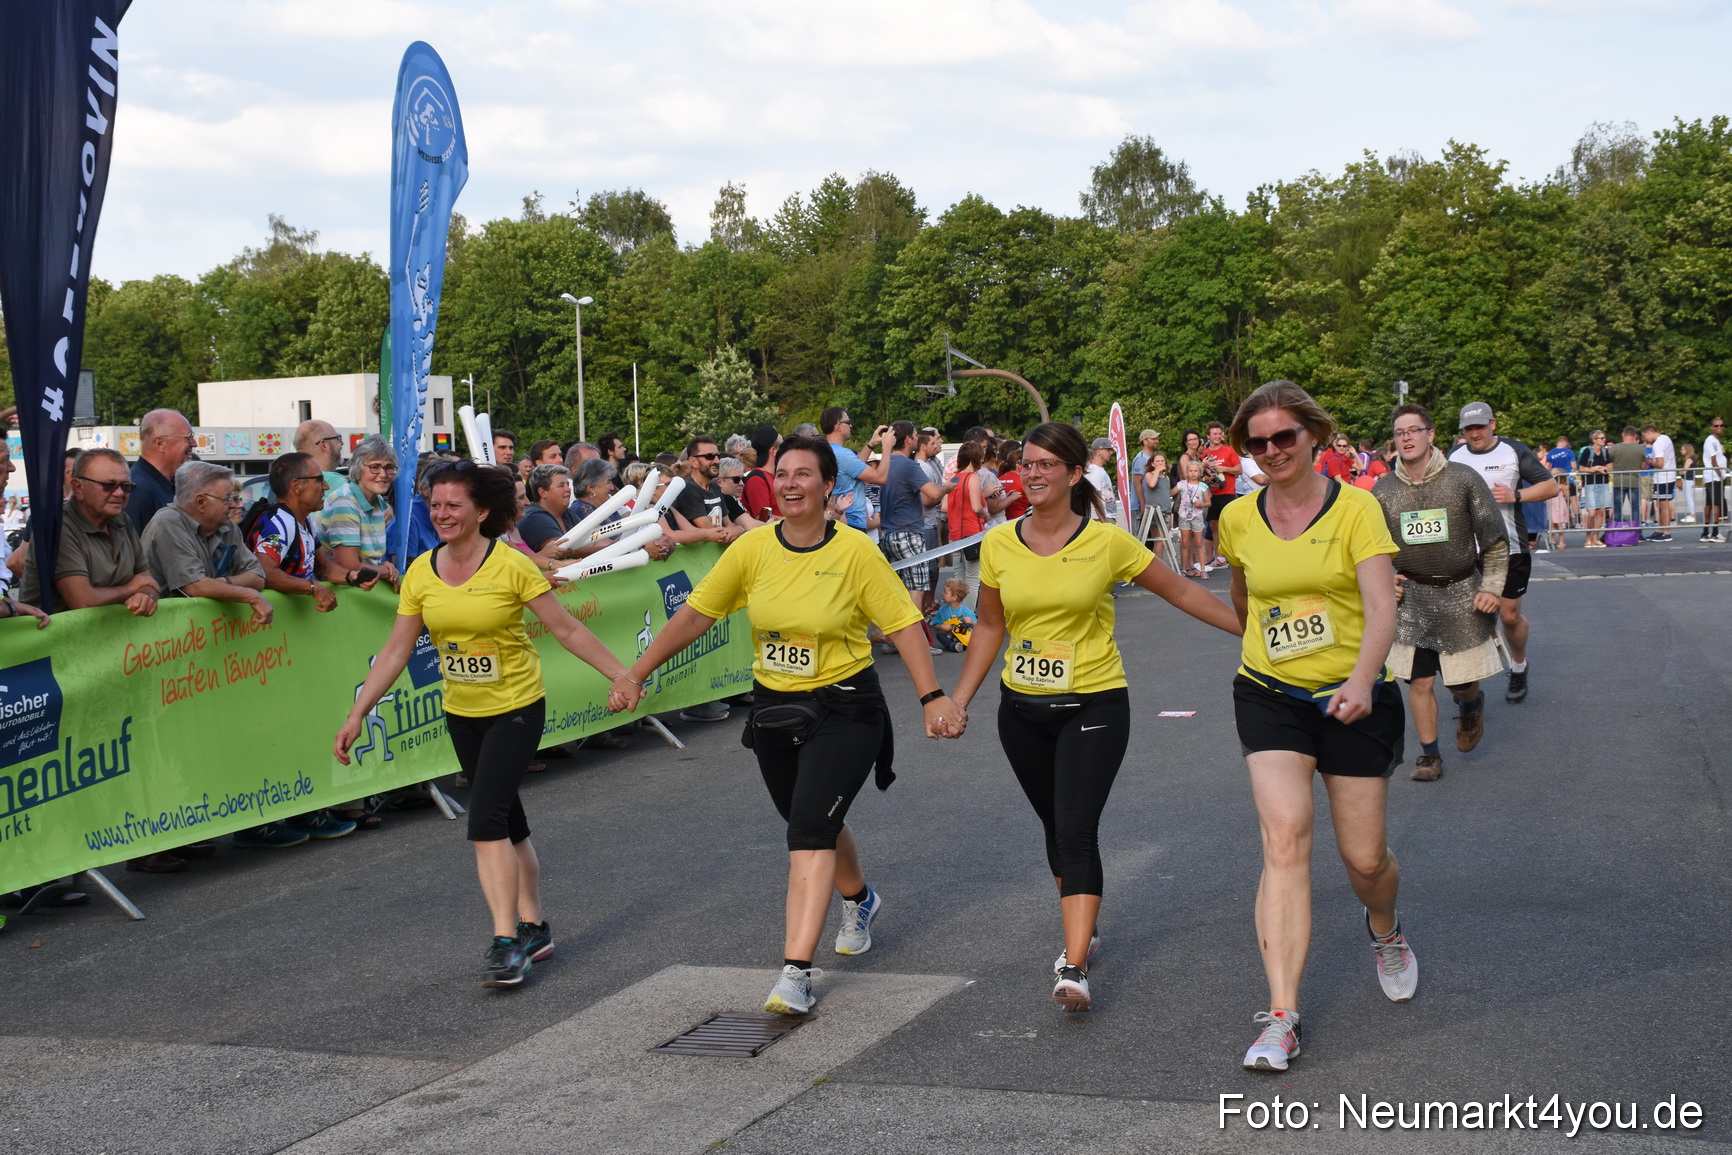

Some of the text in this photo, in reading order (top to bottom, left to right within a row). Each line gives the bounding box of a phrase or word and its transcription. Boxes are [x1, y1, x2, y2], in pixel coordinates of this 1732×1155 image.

[1406, 521, 1442, 536] 2033
[1268, 614, 1325, 648] 2198
[123, 618, 208, 676] Gesunde
[766, 643, 810, 666] 2185
[1275, 643, 1297, 653] Schmid
[1297, 636, 1323, 647] Ramona
[161, 632, 292, 707] laufen länger!
[445, 655, 492, 674] 2189
[665, 662, 698, 687] neumarkt
[1015, 655, 1065, 679] 2196
[1021, 674, 1056, 684] Rupp Sabrina
[0, 692, 49, 720] ischer
[84, 769, 315, 851] www.firmenlauf-oberpfalz.de
